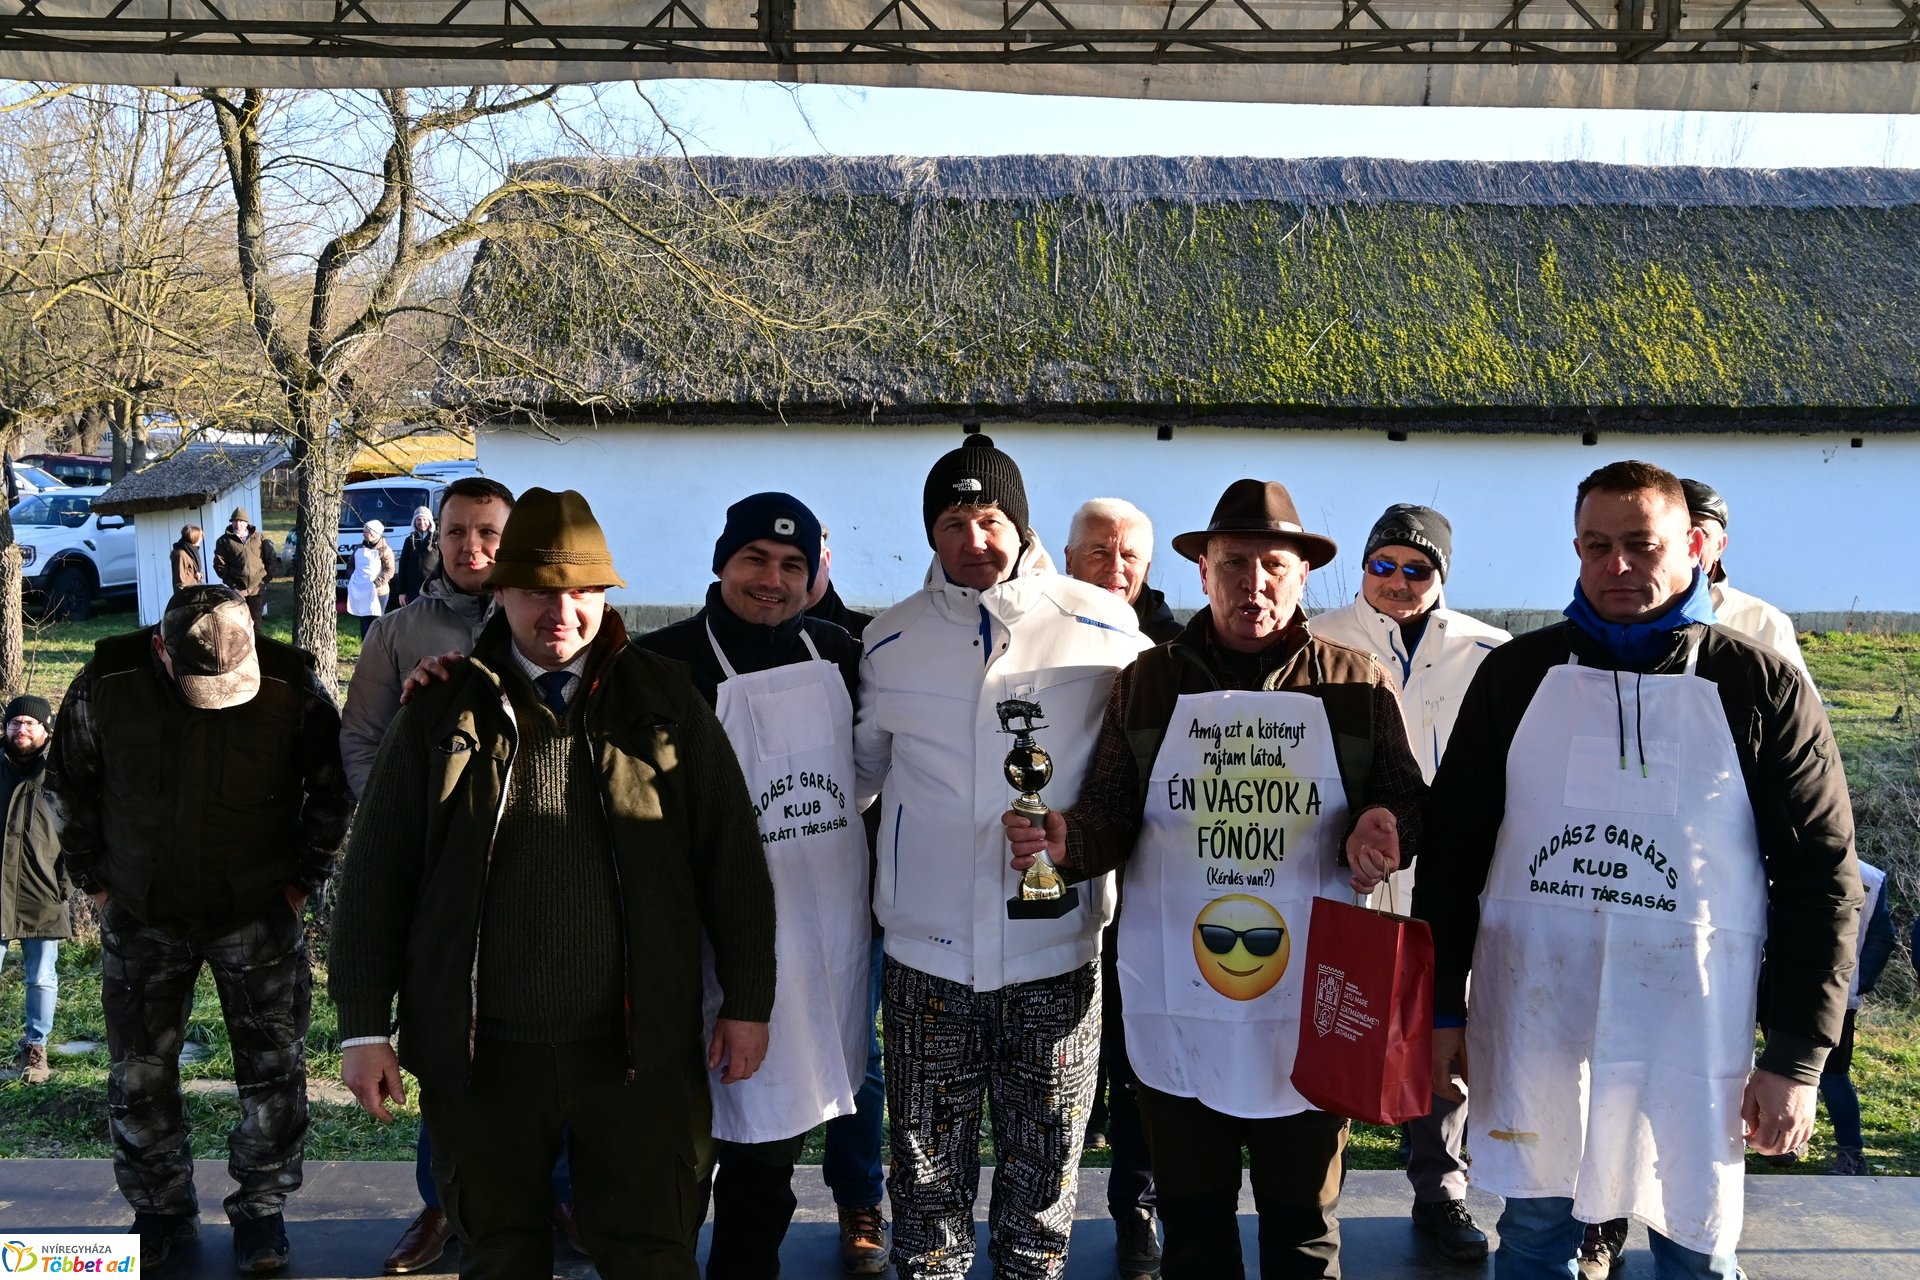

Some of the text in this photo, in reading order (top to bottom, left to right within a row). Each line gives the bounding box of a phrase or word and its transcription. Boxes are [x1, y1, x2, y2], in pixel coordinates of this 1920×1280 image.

[1188, 718, 1307, 749] Amíg ezt a kötényt
[1203, 744, 1286, 775] rajtam látod,
[753, 771, 846, 818] ADÁSZ GARÁZS
[783, 800, 821, 819] KLUB
[1168, 773, 1322, 816] ÉN VAGYOK A
[760, 815, 848, 844] ARÁTI TÁRSASÁG
[1198, 819, 1285, 862] FŐNÖK!
[1529, 824, 1679, 890] VADÁSZ GARÁZS
[1572, 857, 1628, 879] KLUB
[1206, 866, 1275, 887] (Kérdés van?)
[1530, 880, 1677, 912] BARÁTI TÁRSASÁG
